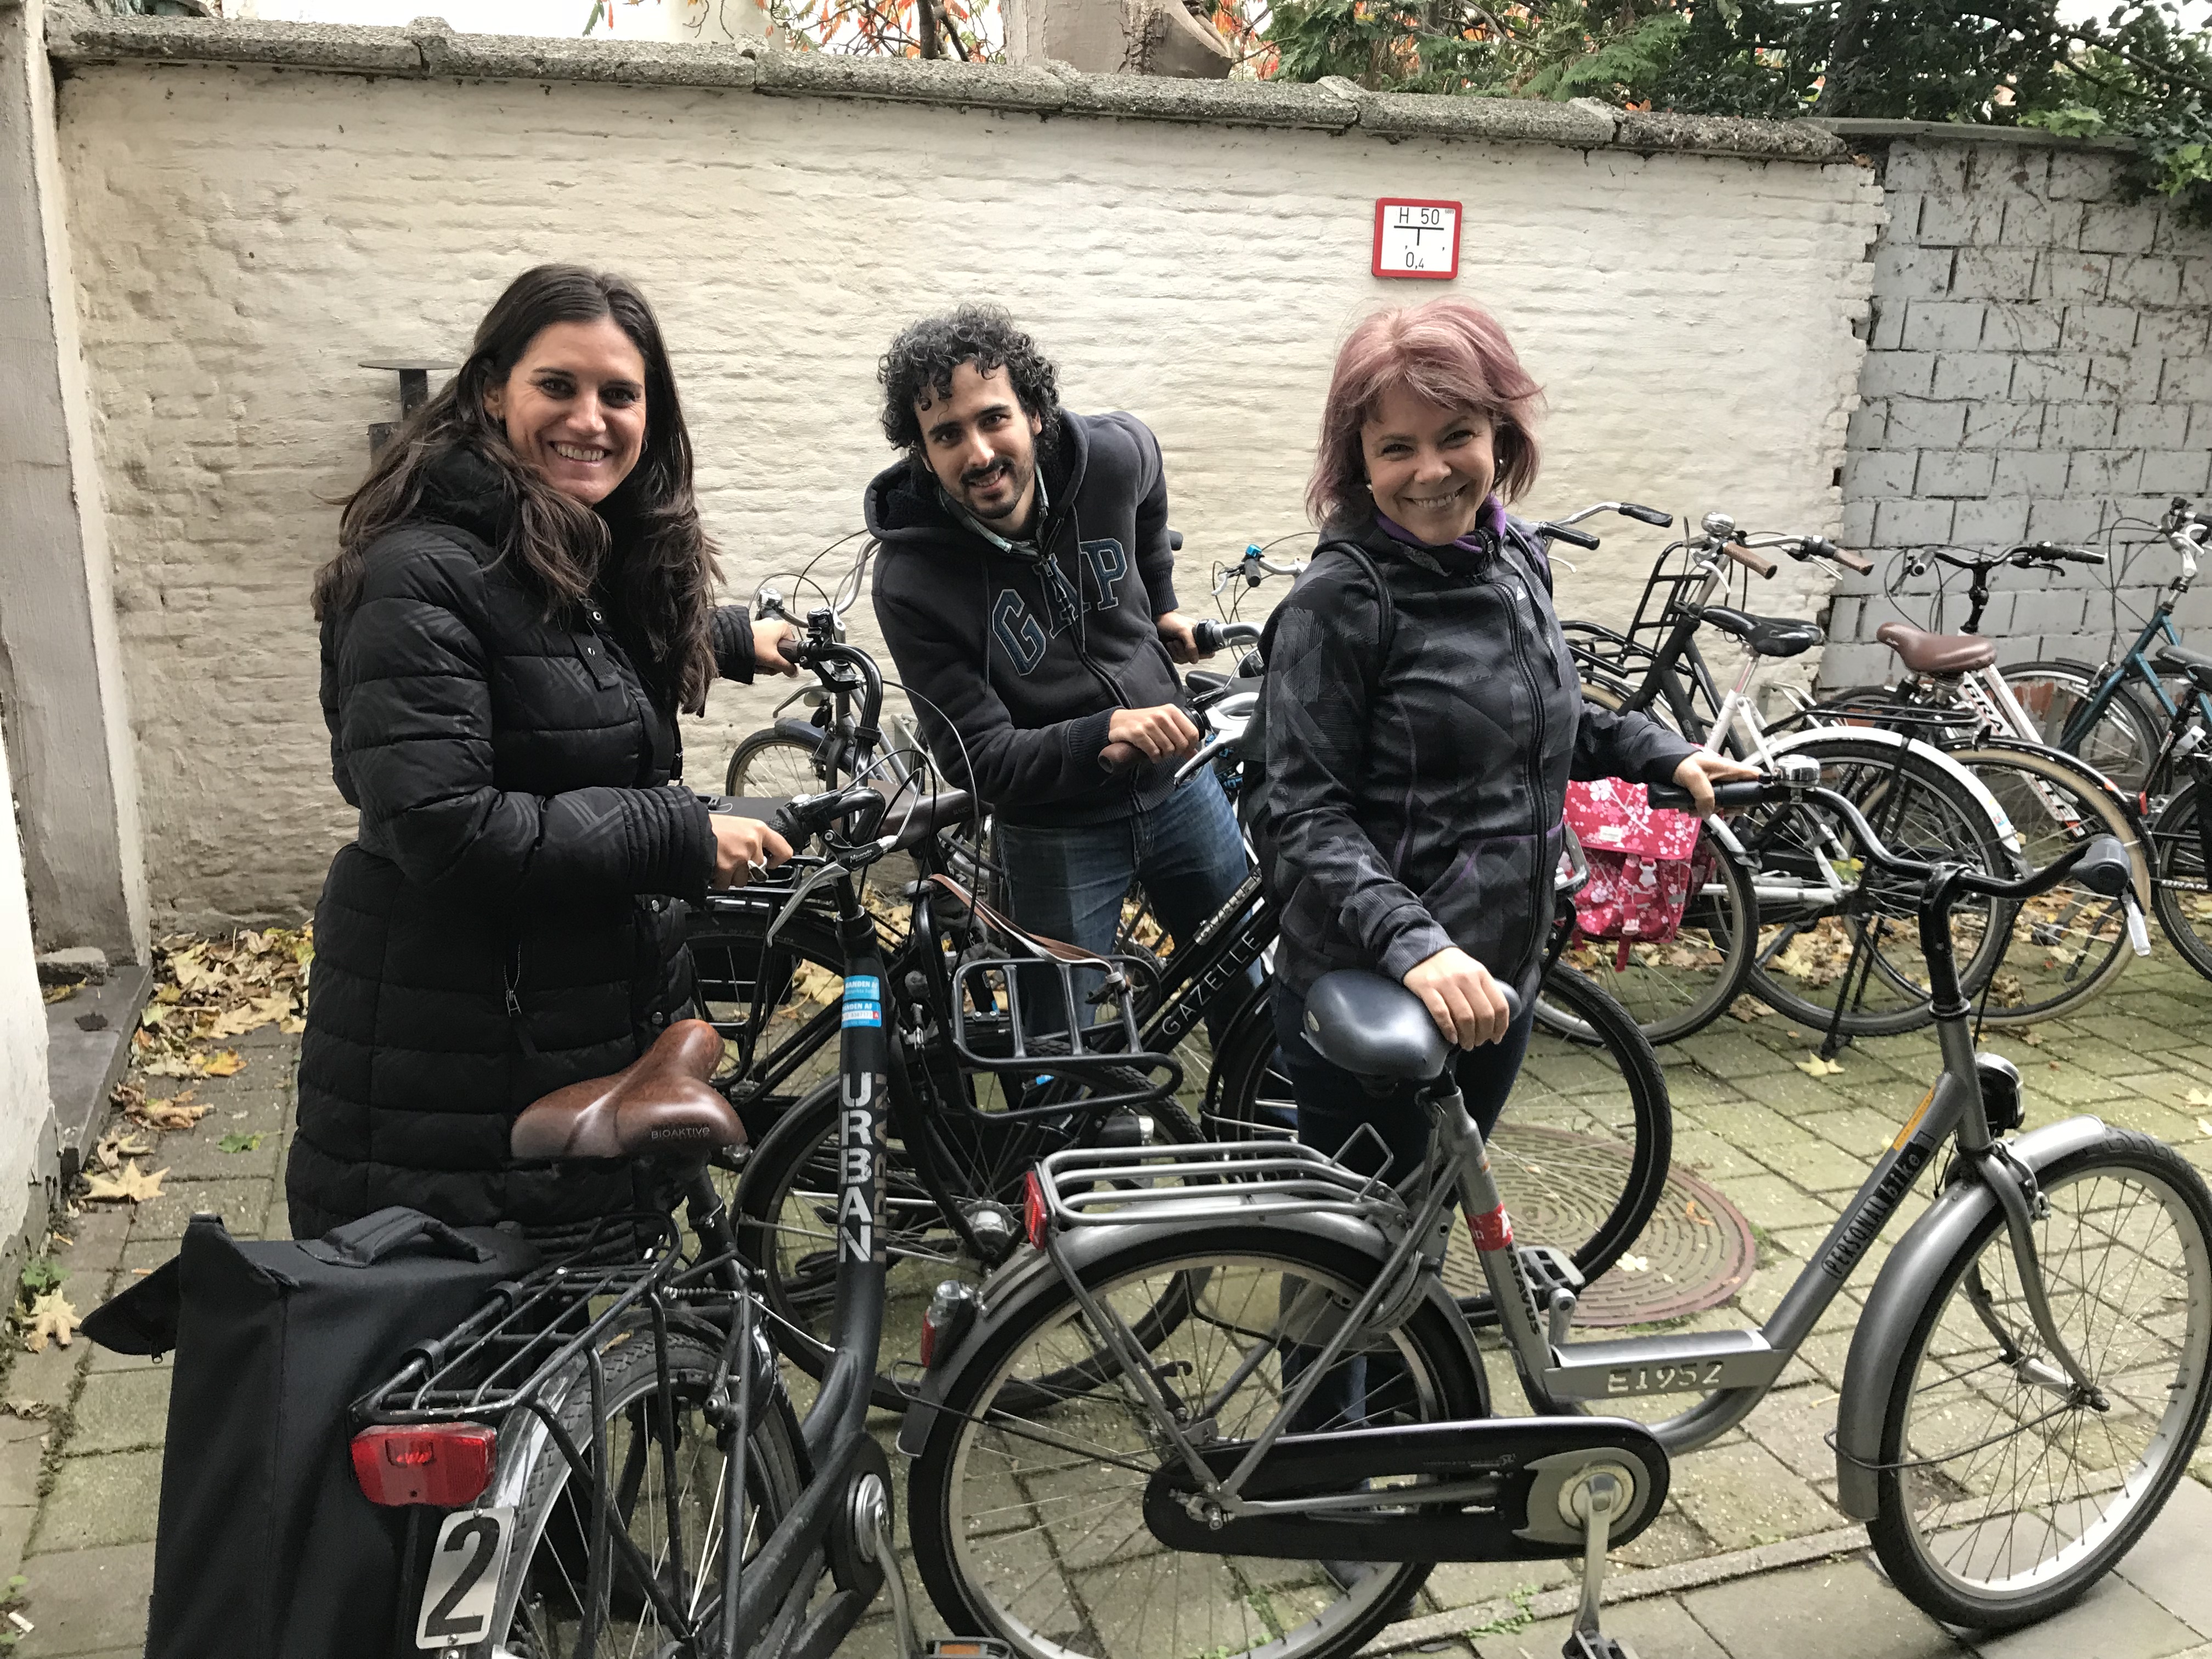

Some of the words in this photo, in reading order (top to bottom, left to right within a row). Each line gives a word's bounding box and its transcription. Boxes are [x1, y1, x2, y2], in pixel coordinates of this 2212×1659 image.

[1399, 207, 1409, 224] H
[1421, 208, 1440, 225] 50
[1406, 251, 1424, 269] 0,4
[992, 538, 1127, 676] GAP
[1161, 930, 1261, 1035] GAZELLE
[840, 1072, 873, 1262] URBAN
[1824, 1196, 1887, 1274] PERSONAL
[1880, 1153, 1921, 1199] bike
[1607, 1361, 1724, 1393] E1952
[424, 1516, 500, 1638] 2
